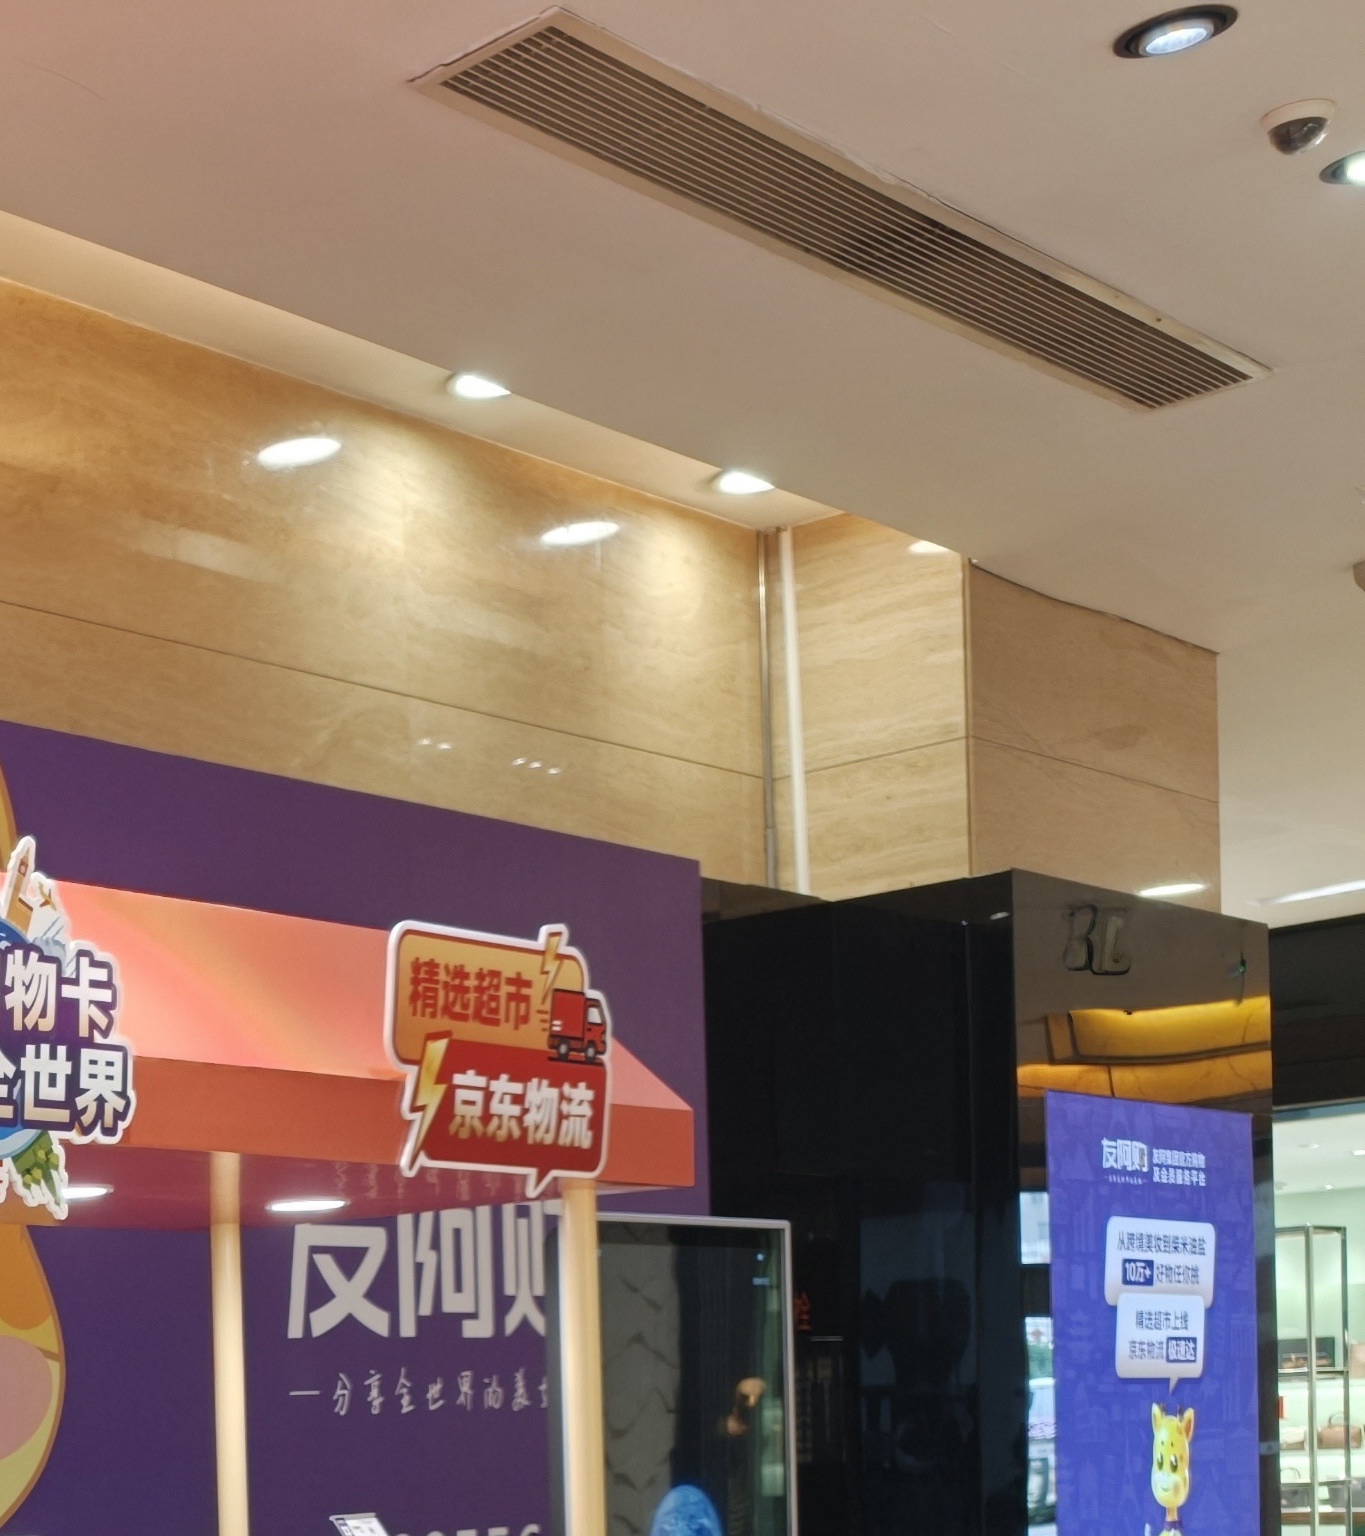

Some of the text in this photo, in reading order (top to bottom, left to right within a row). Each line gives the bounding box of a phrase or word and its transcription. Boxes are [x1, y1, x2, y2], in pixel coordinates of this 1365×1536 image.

[408, 959, 533, 1031] 精选超市
[449, 1070, 595, 1151] 京东物流
[1101, 1136, 1149, 1173] 友阿购
